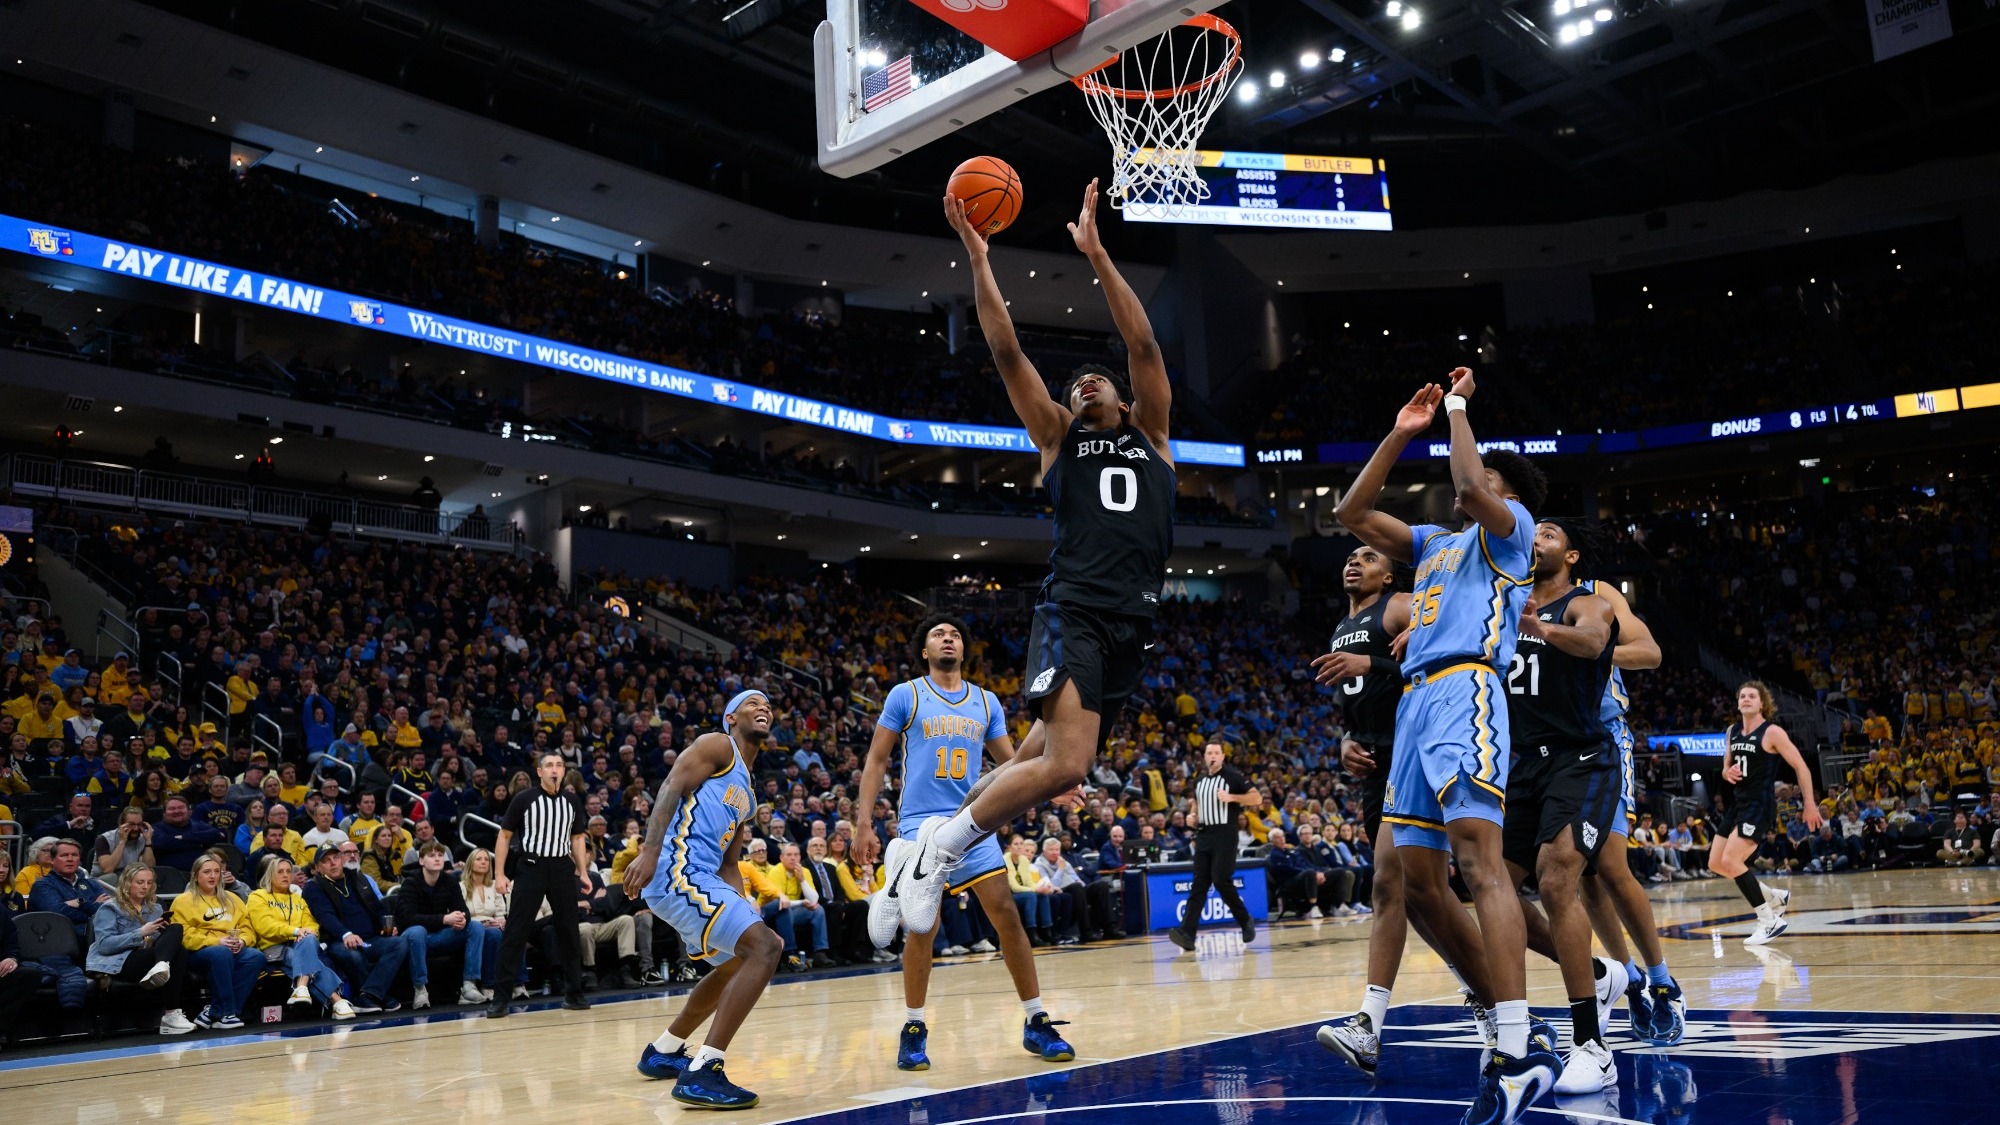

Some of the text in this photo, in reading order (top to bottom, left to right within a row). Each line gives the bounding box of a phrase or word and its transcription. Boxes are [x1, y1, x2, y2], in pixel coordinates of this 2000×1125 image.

[1304, 158, 1352, 171] BUTLER
[1236, 169, 1277, 181] ASSISTS
[1238, 183, 1277, 195] STEALS
[1238, 197, 1278, 209] BLOCKS
[1240, 212, 1320, 225] WISCONSIN'S
[1325, 216, 1356, 225] BANK
[102, 243, 324, 314] PAY LIKE A FAN!
[408, 312, 693, 394] WINTRUST WISCONSIN'S BANK
[66, 397, 93, 411] 106
[751, 390, 785, 414] PAY
[785, 398, 822, 423] LIKE
[822, 407, 835, 426] A
[836, 409, 874, 434] FAN!
[1711, 403, 1879, 437] BONUS 8 FLS 4 TOL
[929, 424, 1013, 447] WINTRUST
[1284, 449, 1302, 461] PM
[1429, 443, 1451, 457] KIL
[1524, 440, 1557, 453] XXXX
[1099, 466, 1138, 512] 0
[1162, 579, 1188, 596] NA
[1410, 584, 1444, 631] 35
[1331, 629, 1371, 653] BUTLER
[1507, 652, 1540, 696] 21
[1539, 745, 1550, 758] B
[934, 746, 967, 781] 10
